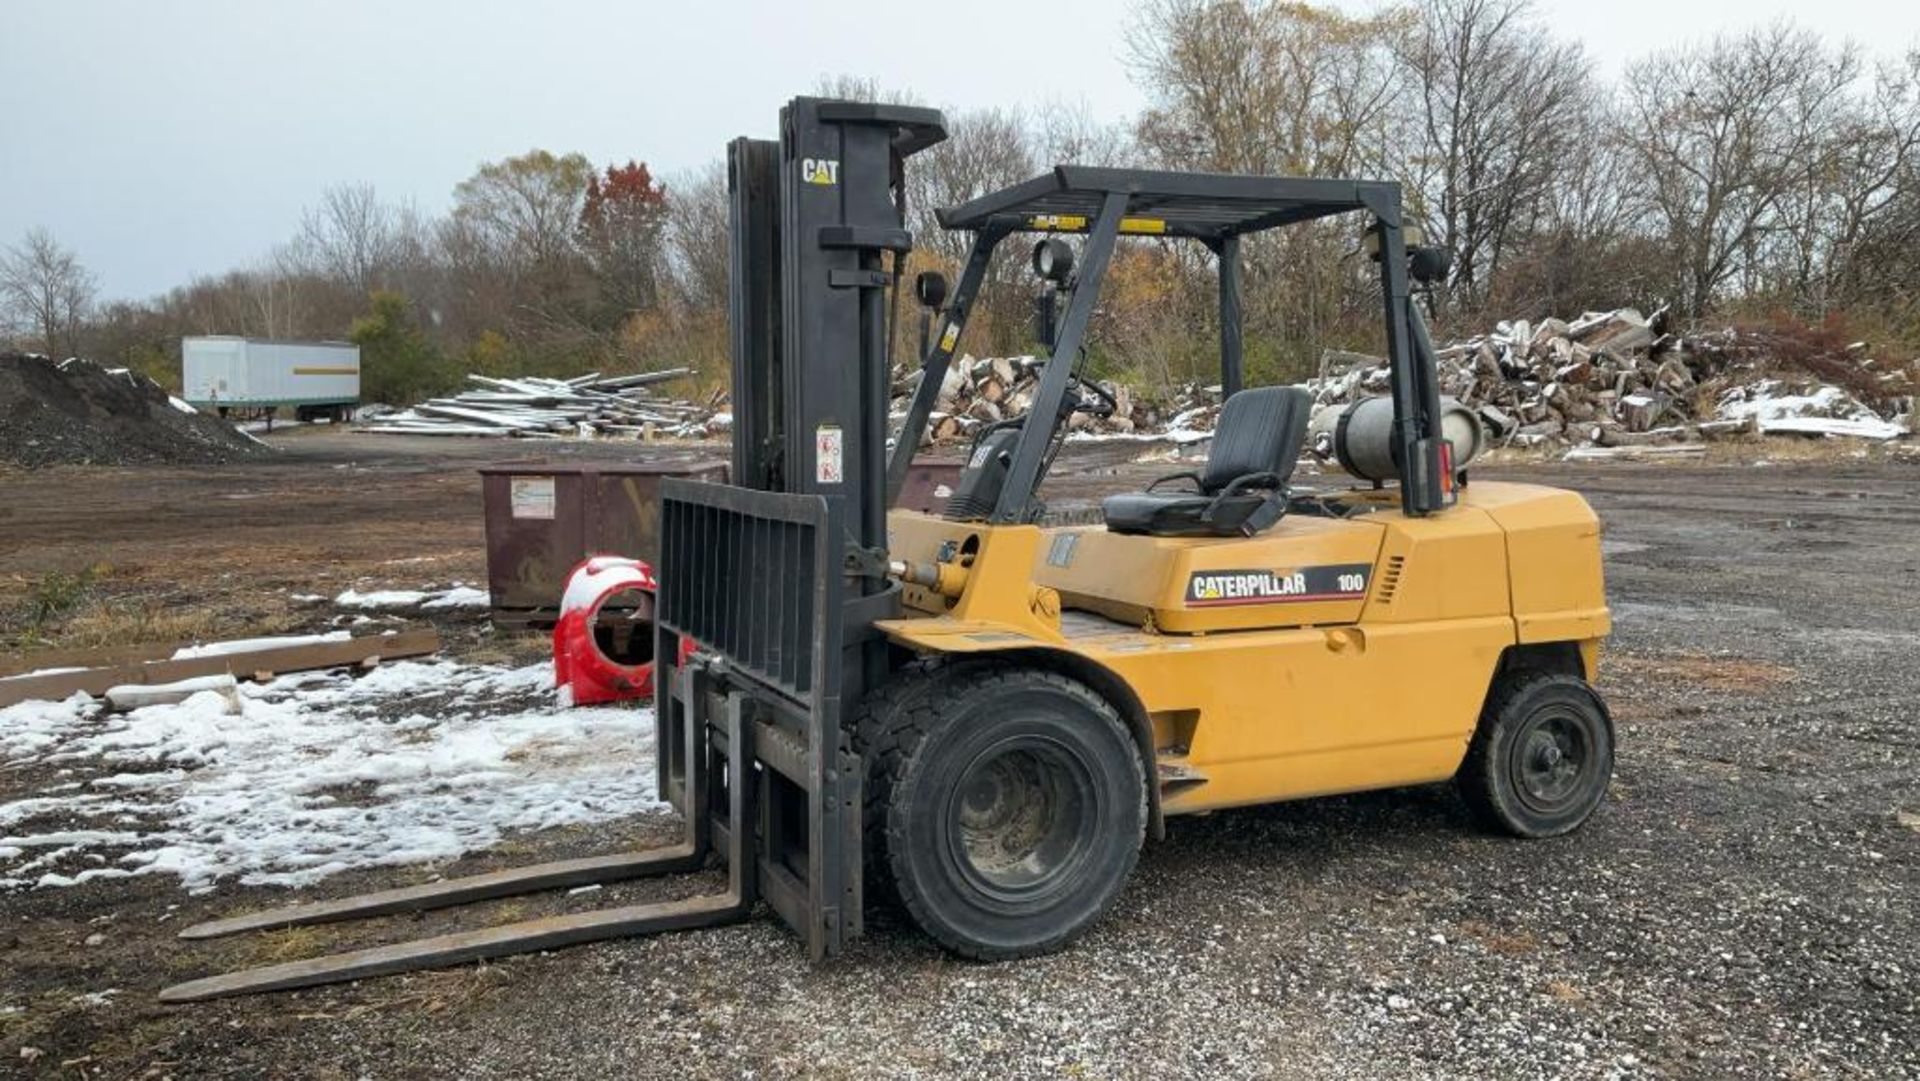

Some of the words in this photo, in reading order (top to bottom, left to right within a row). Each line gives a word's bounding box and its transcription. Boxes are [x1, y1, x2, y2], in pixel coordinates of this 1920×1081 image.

[803, 159, 839, 184] CAT
[1193, 574, 1306, 598] CATERPILLAR
[1338, 575, 1364, 591] 100
